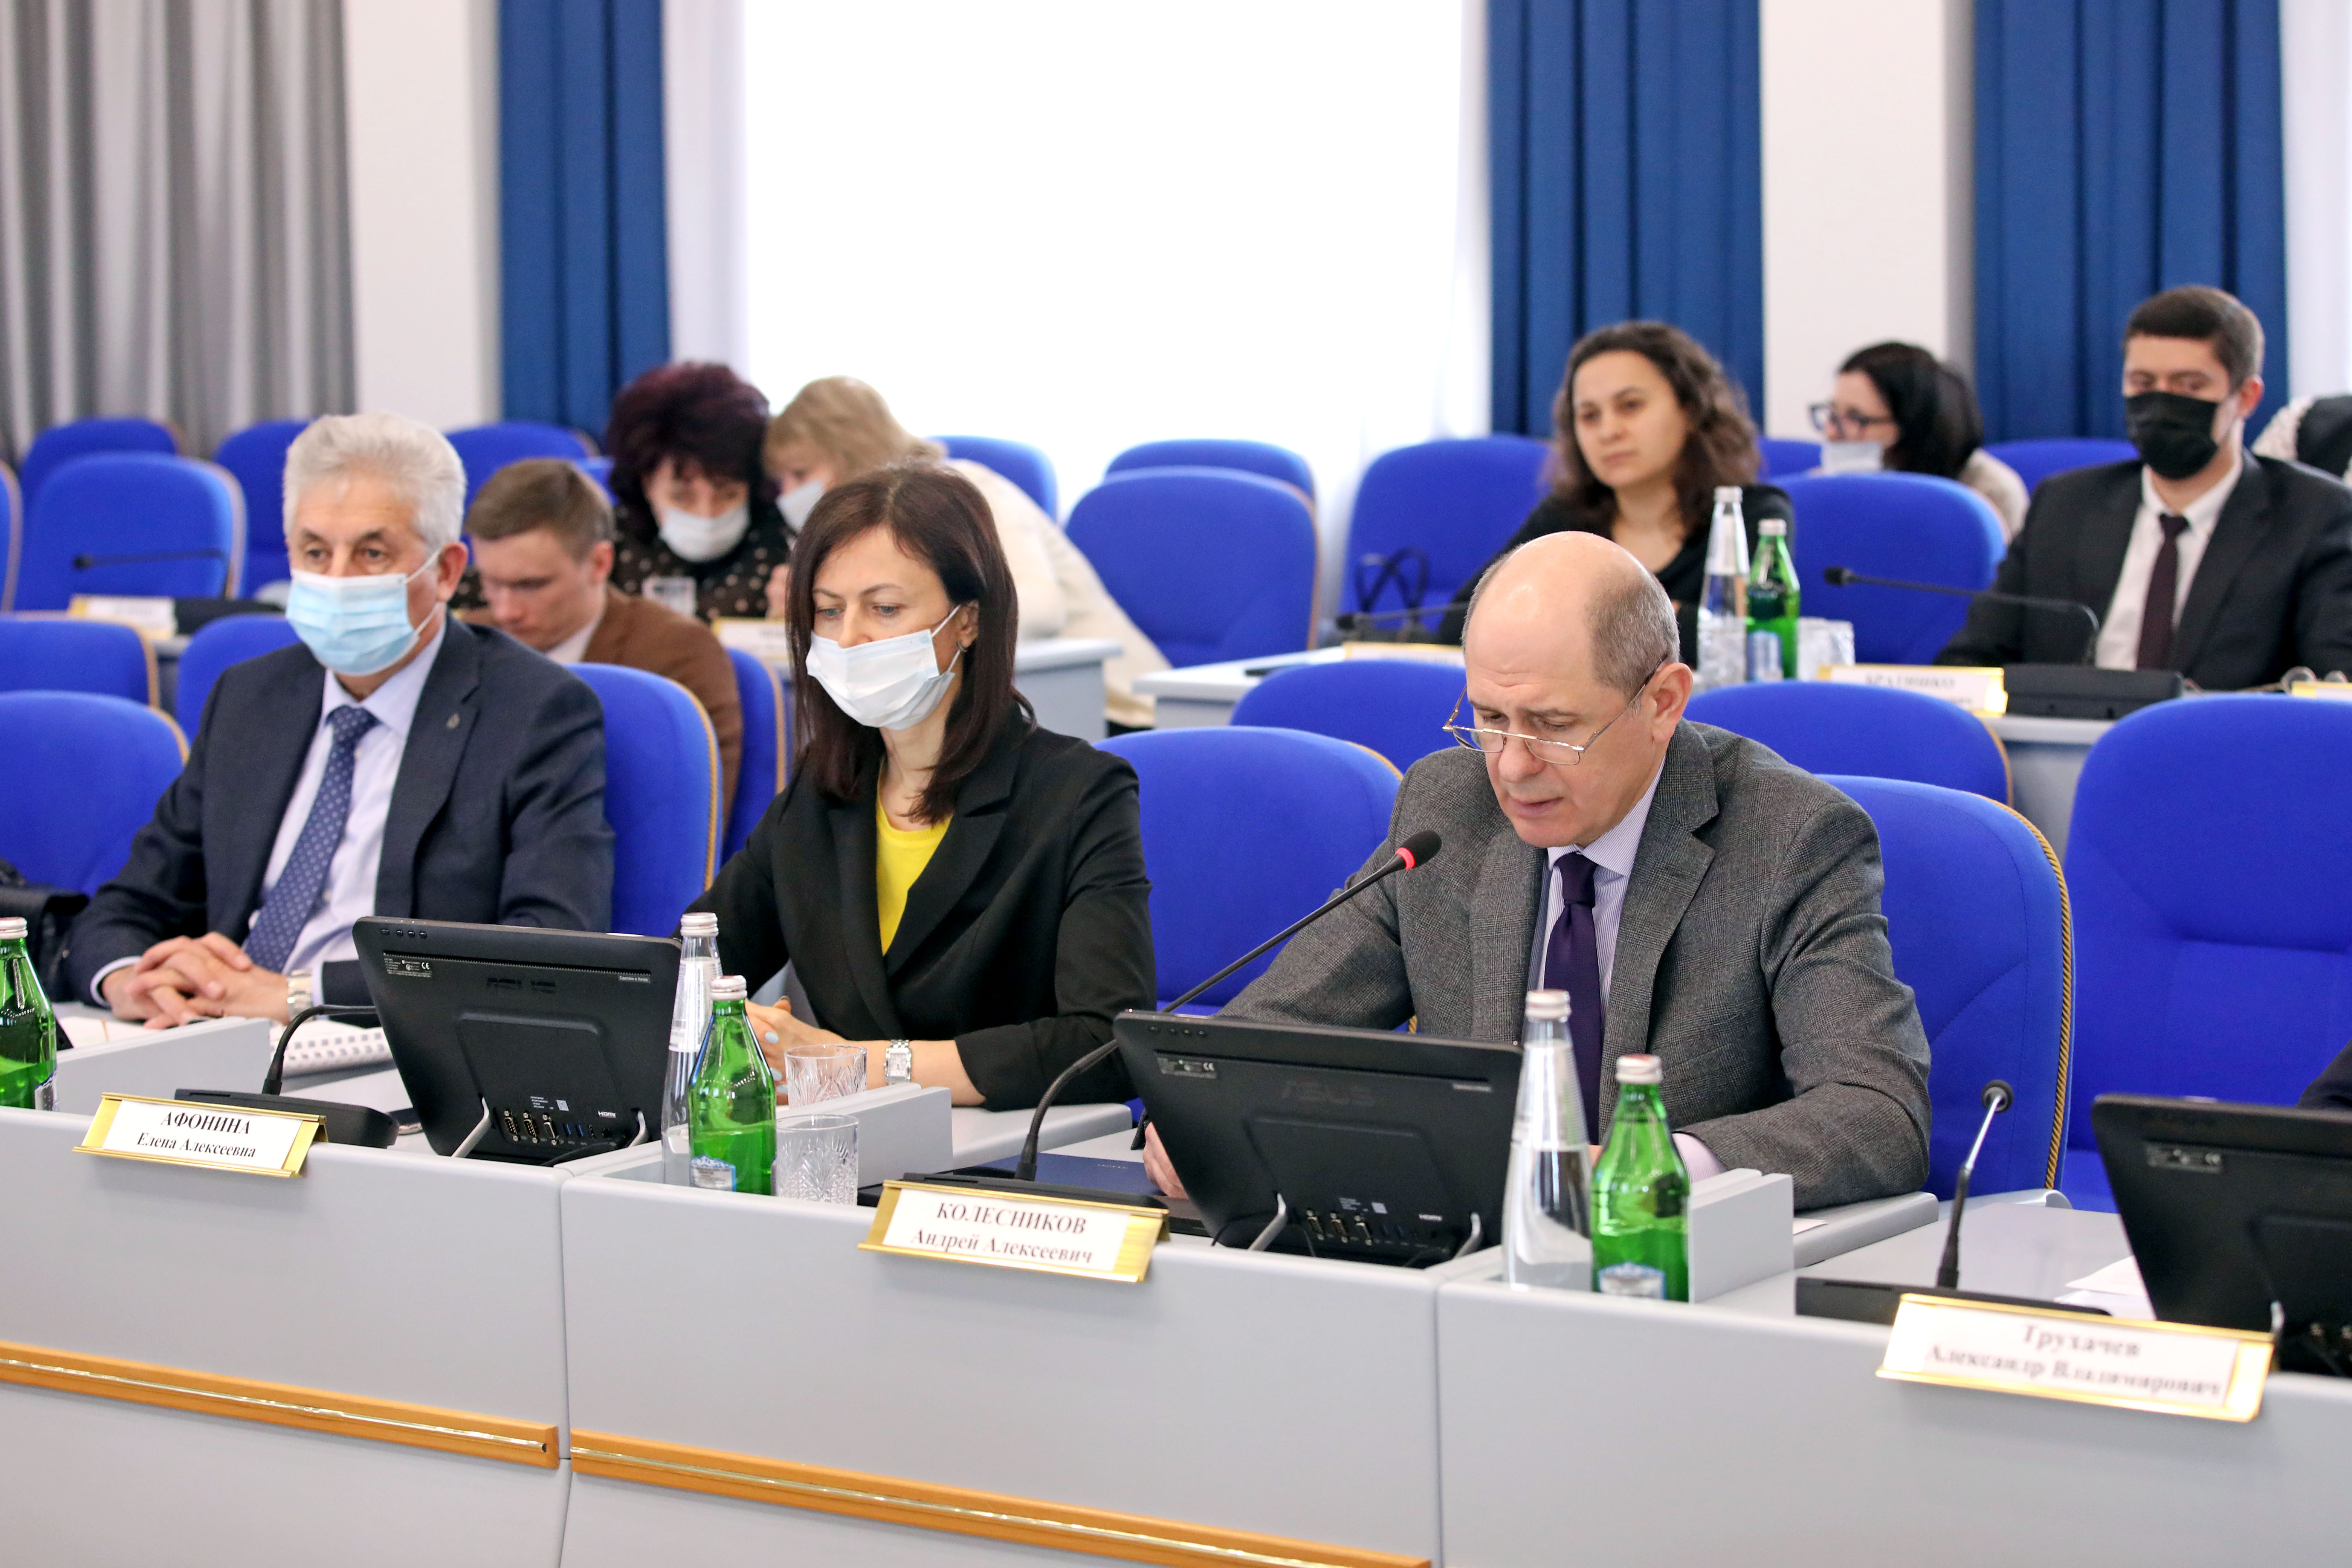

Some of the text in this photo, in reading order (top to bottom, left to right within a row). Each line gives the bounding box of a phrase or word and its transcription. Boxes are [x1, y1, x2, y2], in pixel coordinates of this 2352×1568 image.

[161, 1111, 251, 1134] АФОНИНА
[137, 1132, 257, 1158] Елена Алексеевна
[936, 1202, 1087, 1234] КОЛЕСНИКОВ
[911, 1228, 1093, 1264] Андрей Алексеевич
[1926, 1344, 2220, 1396] Александр Владимирович
